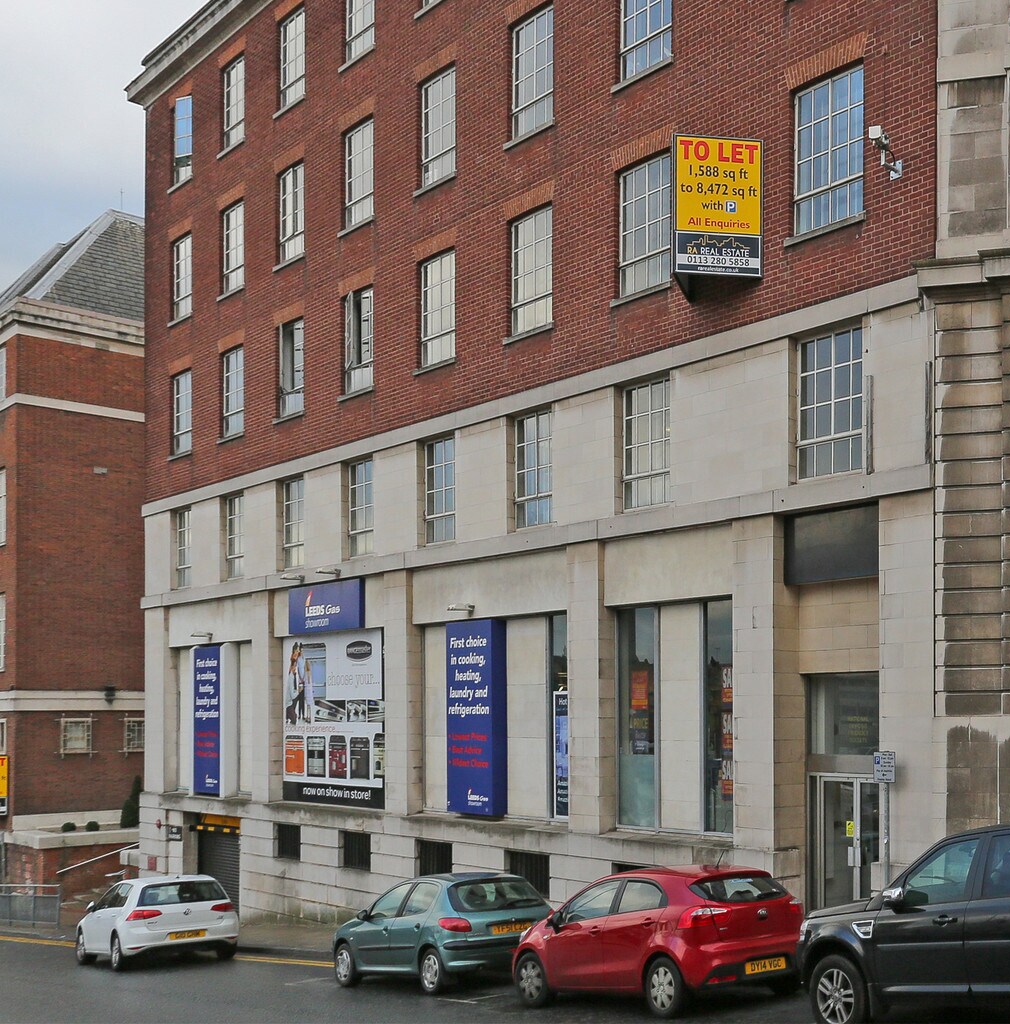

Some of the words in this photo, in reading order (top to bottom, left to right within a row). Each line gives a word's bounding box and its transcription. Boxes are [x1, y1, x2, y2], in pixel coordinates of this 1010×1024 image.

[680, 140, 710, 162] TO
[718, 142, 758, 164] LET
[689, 165, 719, 178] 1,588
[723, 170, 736, 182] sq
[739, 168, 748, 179] ft
[681, 183, 693, 193] to
[696, 183, 728, 196] 8,472
[732, 187, 744, 199] sq
[748, 186, 757, 197] ft
[702, 200, 723, 210] with
[688, 217, 701, 226] All
[705, 218, 750, 230] Enquiries
[687, 246, 698, 254] RA
[701, 246, 719, 256] REAL
[722, 248, 750, 257] ESTATE
[711, 257, 726, 265] 280
[729, 258, 750, 266] 5858
[305, 605, 324, 617] LEEDS
[326, 604, 340, 614] Gas
[305, 618, 329, 628] showroom
[450, 637, 464, 648] First
[466, 636, 487, 647] choice
[450, 654, 456, 665] in
[458, 653, 486, 667] cooking,
[328, 672, 353, 686] choose
[455, 670, 482, 683] heating,
[449, 686, 473, 701] laundry
[475, 686, 488, 697] and
[448, 703, 490, 717] refrigeration
[285, 726, 305, 734] cooking
[326, 786, 344, 797] show
[344, 788, 350, 798] in
[350, 790, 371, 800] store!
[750, 961, 766, 971] DY14
